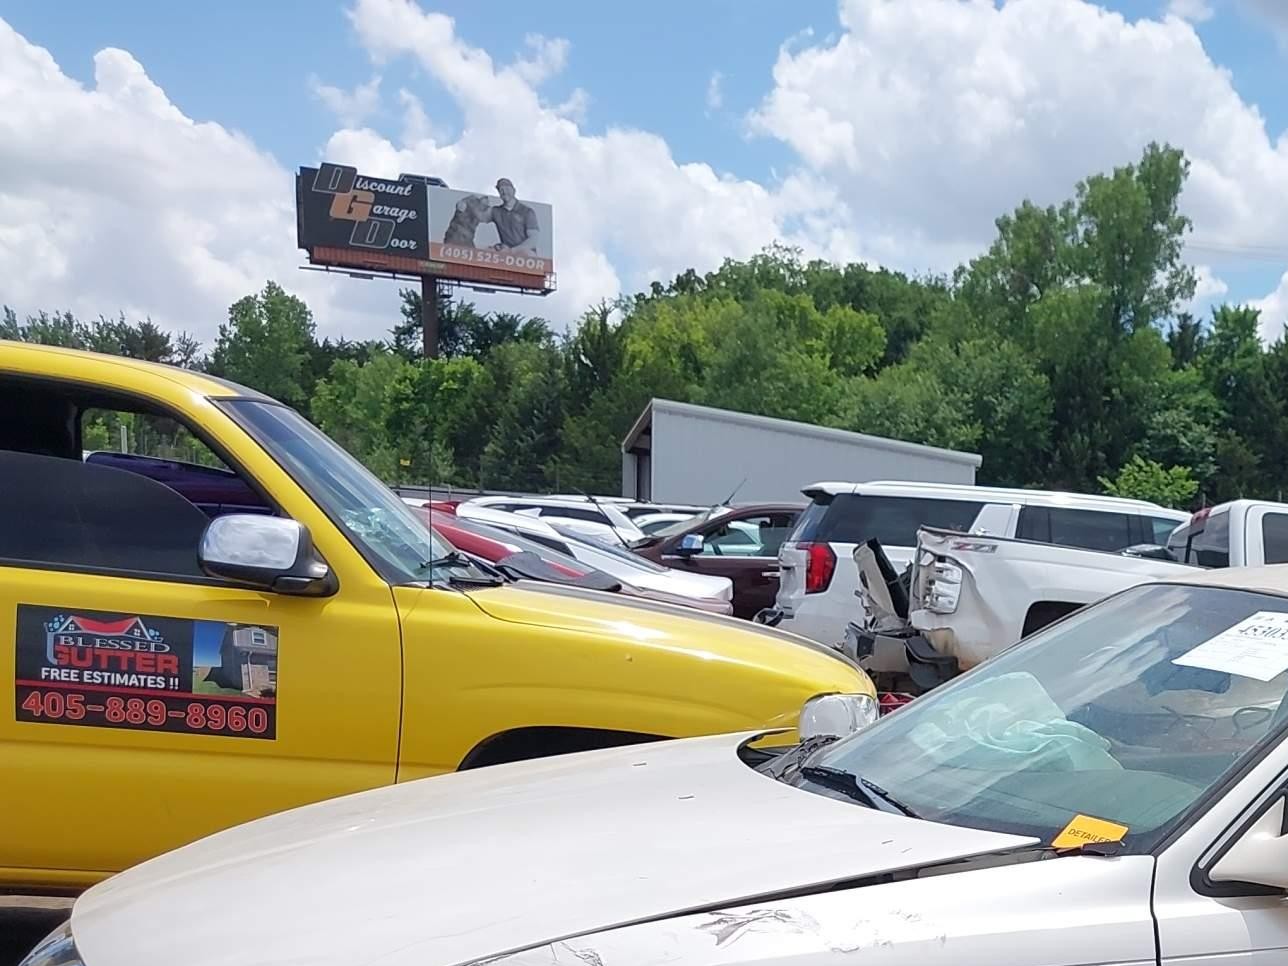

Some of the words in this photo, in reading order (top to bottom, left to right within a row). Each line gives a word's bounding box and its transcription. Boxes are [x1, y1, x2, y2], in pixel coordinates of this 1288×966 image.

[312, 163, 413, 196] Discount
[329, 191, 418, 221] Garage
[350, 217, 418, 250] Door
[439, 245, 473, 262] (405)
[476, 250, 546, 271] 525-DOOR
[58, 635, 171, 653] BLESSED
[54, 645, 180, 674] GUTTER
[41, 667, 80, 682] FREE
[83, 671, 166, 689] ESTIMATES
[168, 677, 180, 690] !!
[22, 691, 269, 733] 405-889-8960
